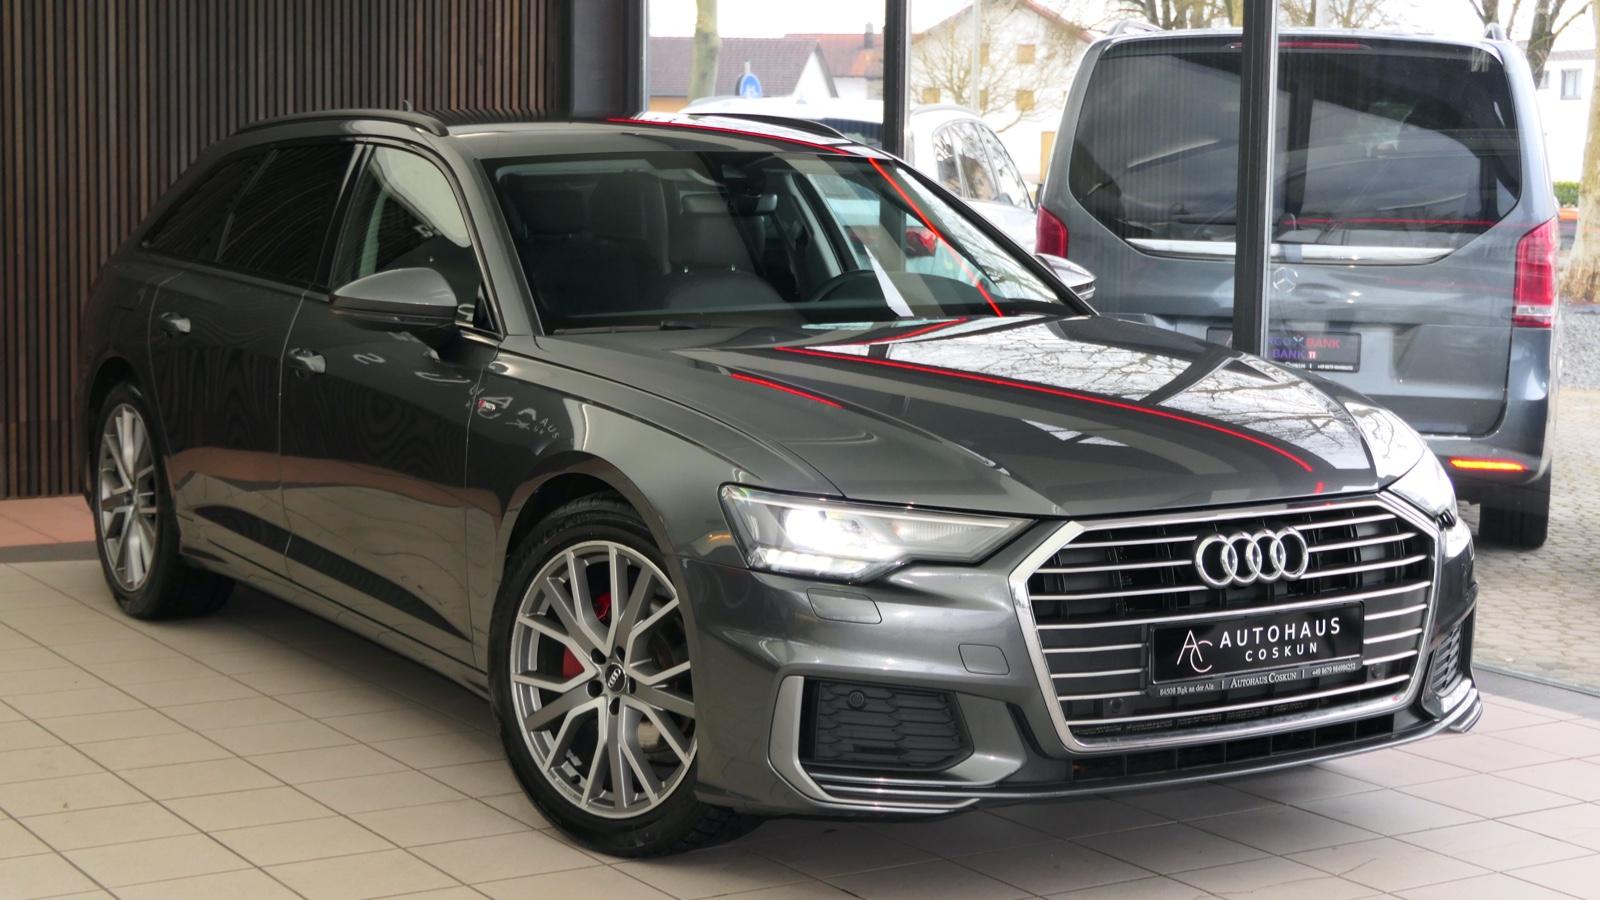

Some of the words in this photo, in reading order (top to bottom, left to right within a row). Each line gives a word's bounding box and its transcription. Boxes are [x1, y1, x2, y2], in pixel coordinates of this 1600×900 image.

[1306, 337, 1341, 349] BANK
[1219, 617, 1341, 649] AUTOHAUS
[1245, 641, 1318, 663] COSKUN
